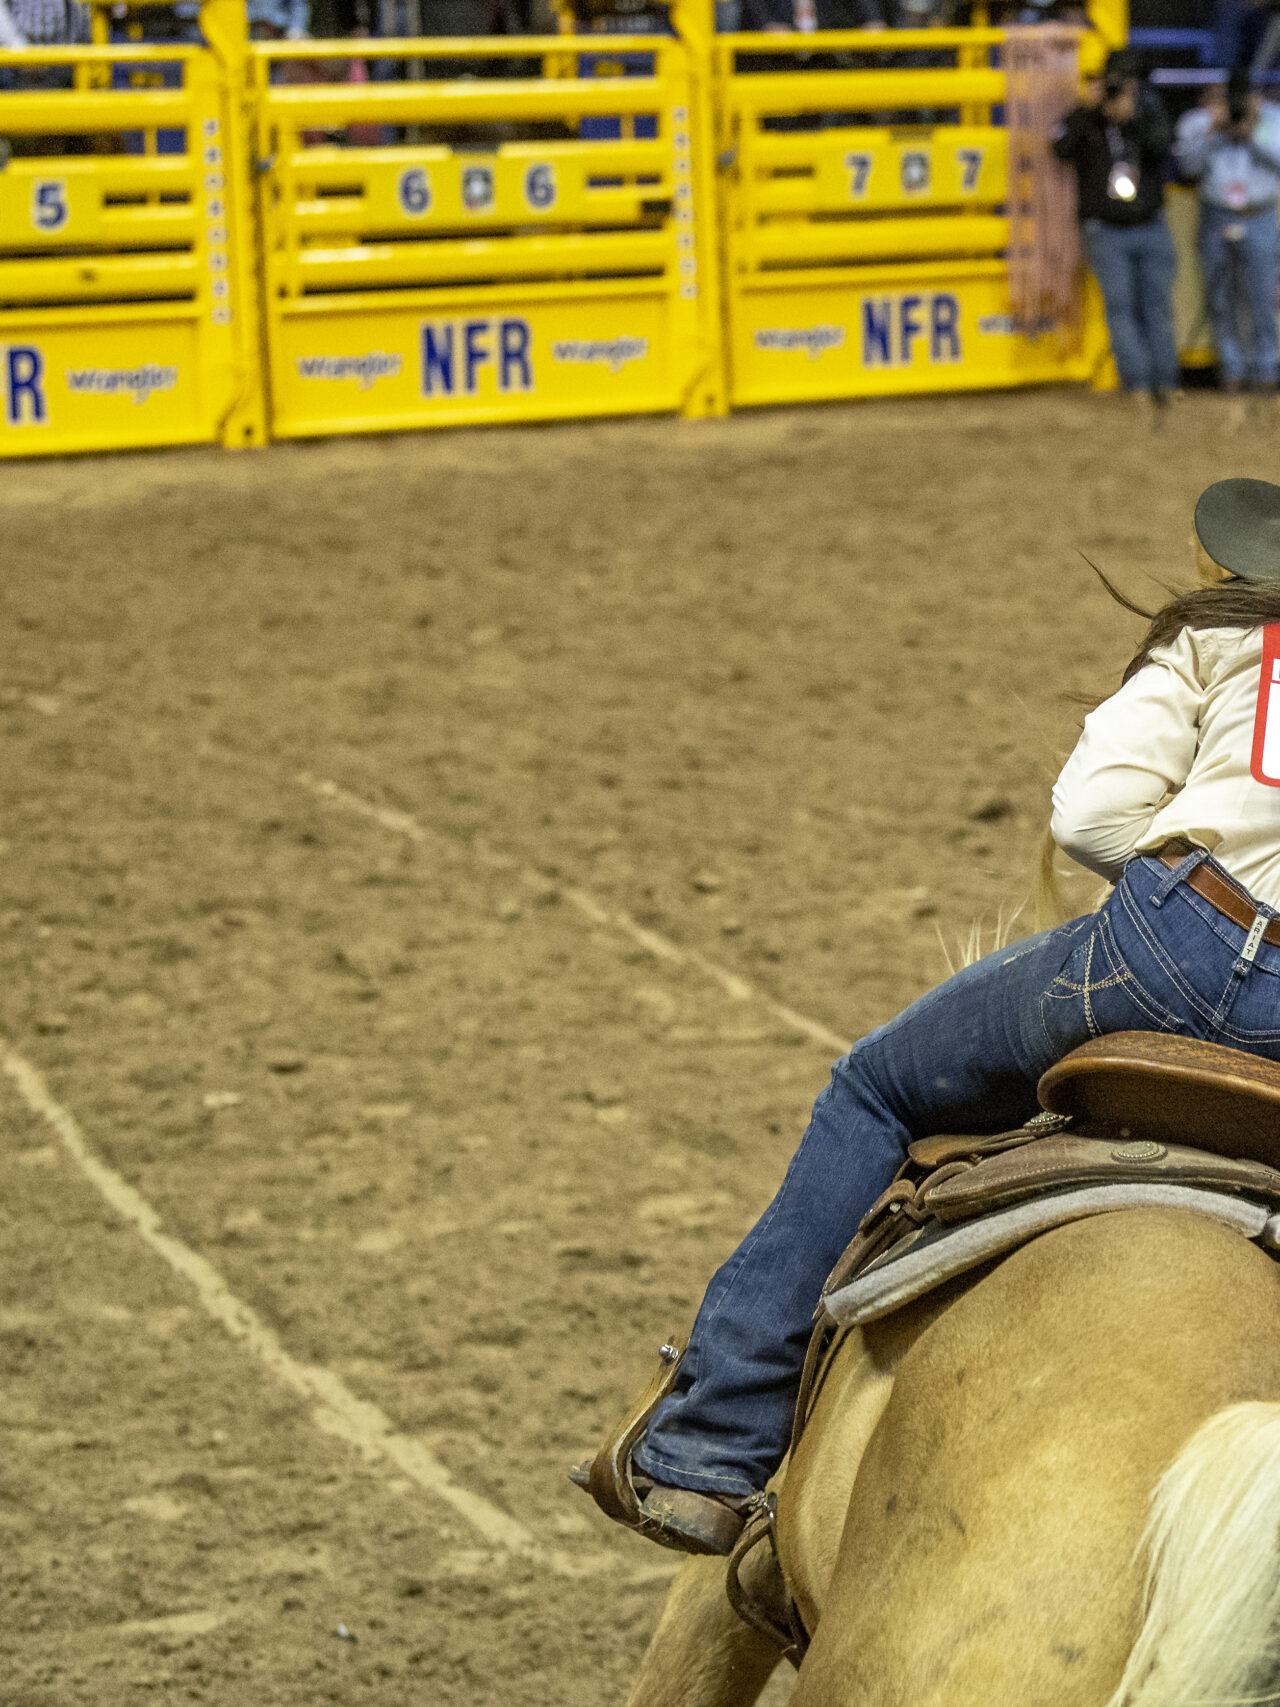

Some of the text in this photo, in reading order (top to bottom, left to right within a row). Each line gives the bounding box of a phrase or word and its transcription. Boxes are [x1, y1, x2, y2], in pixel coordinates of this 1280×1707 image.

[400, 168, 431, 216] 6
[526, 163, 557, 209] 6
[846, 154, 871, 196] 7
[958, 150, 982, 189] 7
[35, 183, 67, 227] 5
[862, 295, 962, 366] NFR
[422, 321, 534, 394] NFR
[1247, 921, 1262, 954] ARIAT
